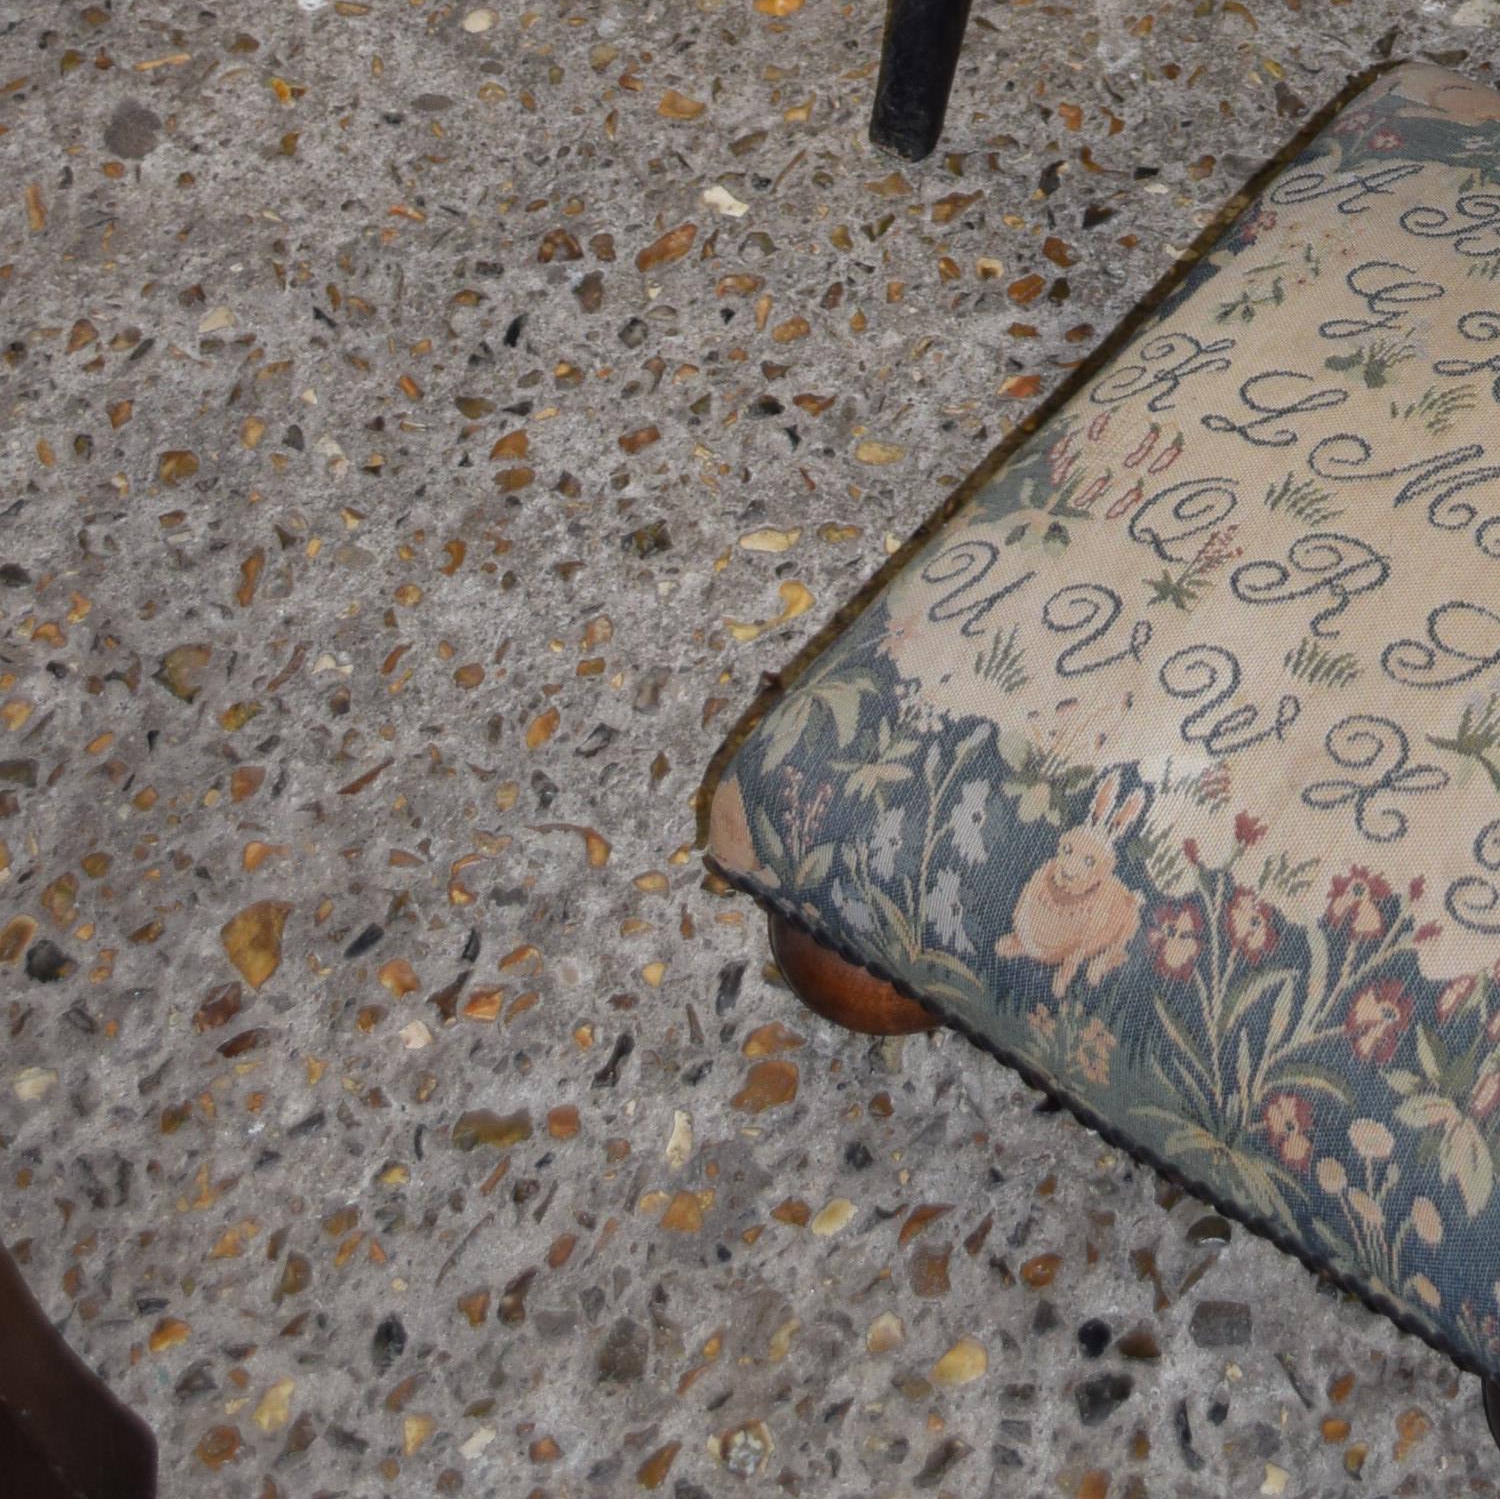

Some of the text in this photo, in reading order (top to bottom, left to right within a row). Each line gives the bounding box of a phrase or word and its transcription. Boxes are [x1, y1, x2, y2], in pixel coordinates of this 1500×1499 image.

[1270, 163, 1425, 213] A
[1319, 260, 1445, 339] G
[1090, 332, 1236, 412] K
[1202, 370, 1349, 447] L
[1129, 477, 1239, 562] Q
[1230, 534, 1391, 639] R
[922, 540, 1035, 636] U
[1043, 583, 1152, 677] V
[1160, 643, 1300, 757] W
[1301, 714, 1451, 842] X
